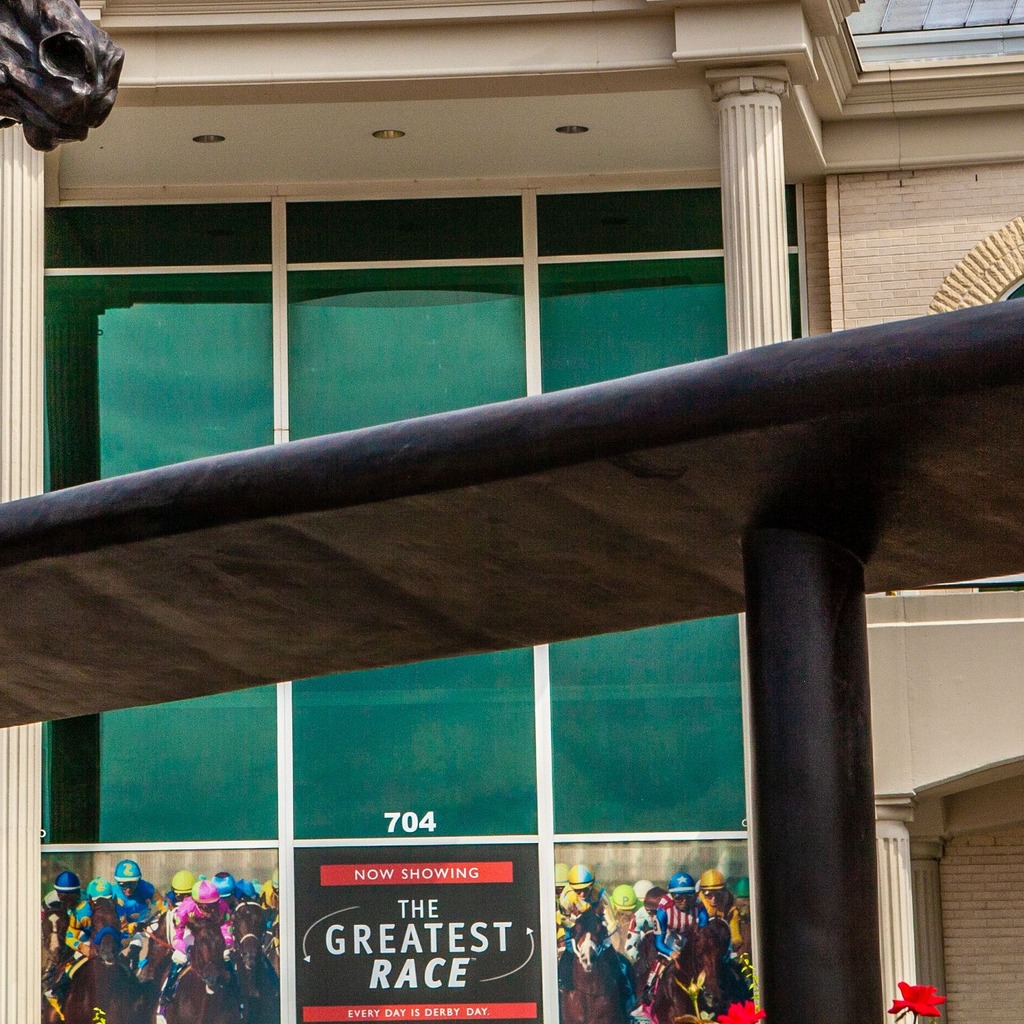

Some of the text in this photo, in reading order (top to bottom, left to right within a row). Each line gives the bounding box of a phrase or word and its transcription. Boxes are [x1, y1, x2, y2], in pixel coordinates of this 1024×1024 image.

[384, 811, 437, 833] 704
[354, 867, 479, 881] NOW SHOWING
[398, 899, 439, 919] THE
[326, 921, 513, 955] GREATEST
[369, 957, 471, 989] RACE
[347, 1007, 490, 1018] EVERY DAY IS DERBY DAY.
